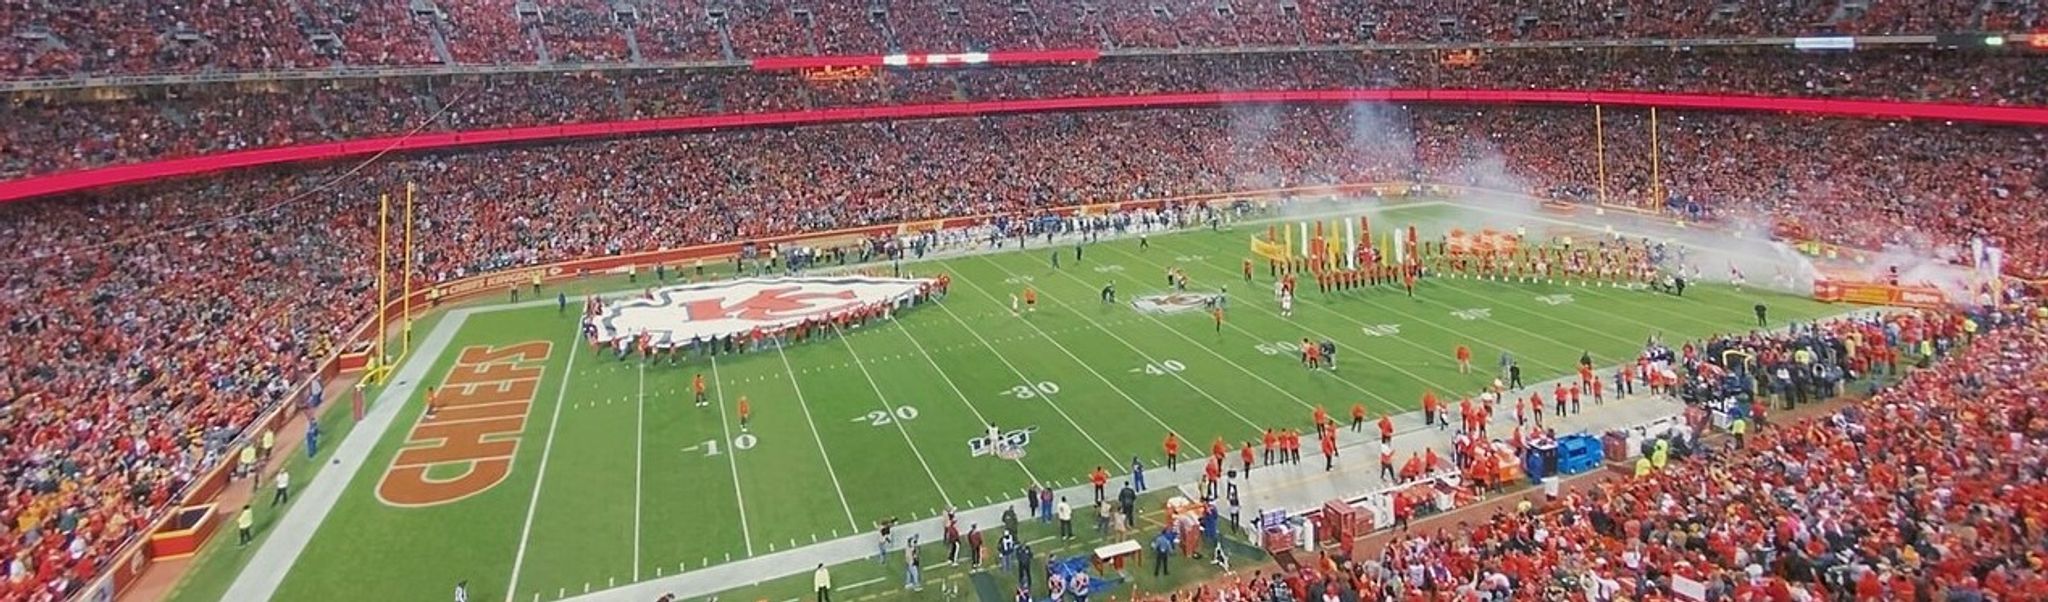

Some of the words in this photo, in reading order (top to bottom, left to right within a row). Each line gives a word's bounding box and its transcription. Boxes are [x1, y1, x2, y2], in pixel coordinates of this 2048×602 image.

[1254, 341, 1299, 355] 50
[1144, 359, 1187, 376] 40
[1012, 381, 1060, 399] 30
[374, 340, 553, 508] CHIEFS
[867, 405, 918, 426] 20
[702, 433, 757, 457] 10
